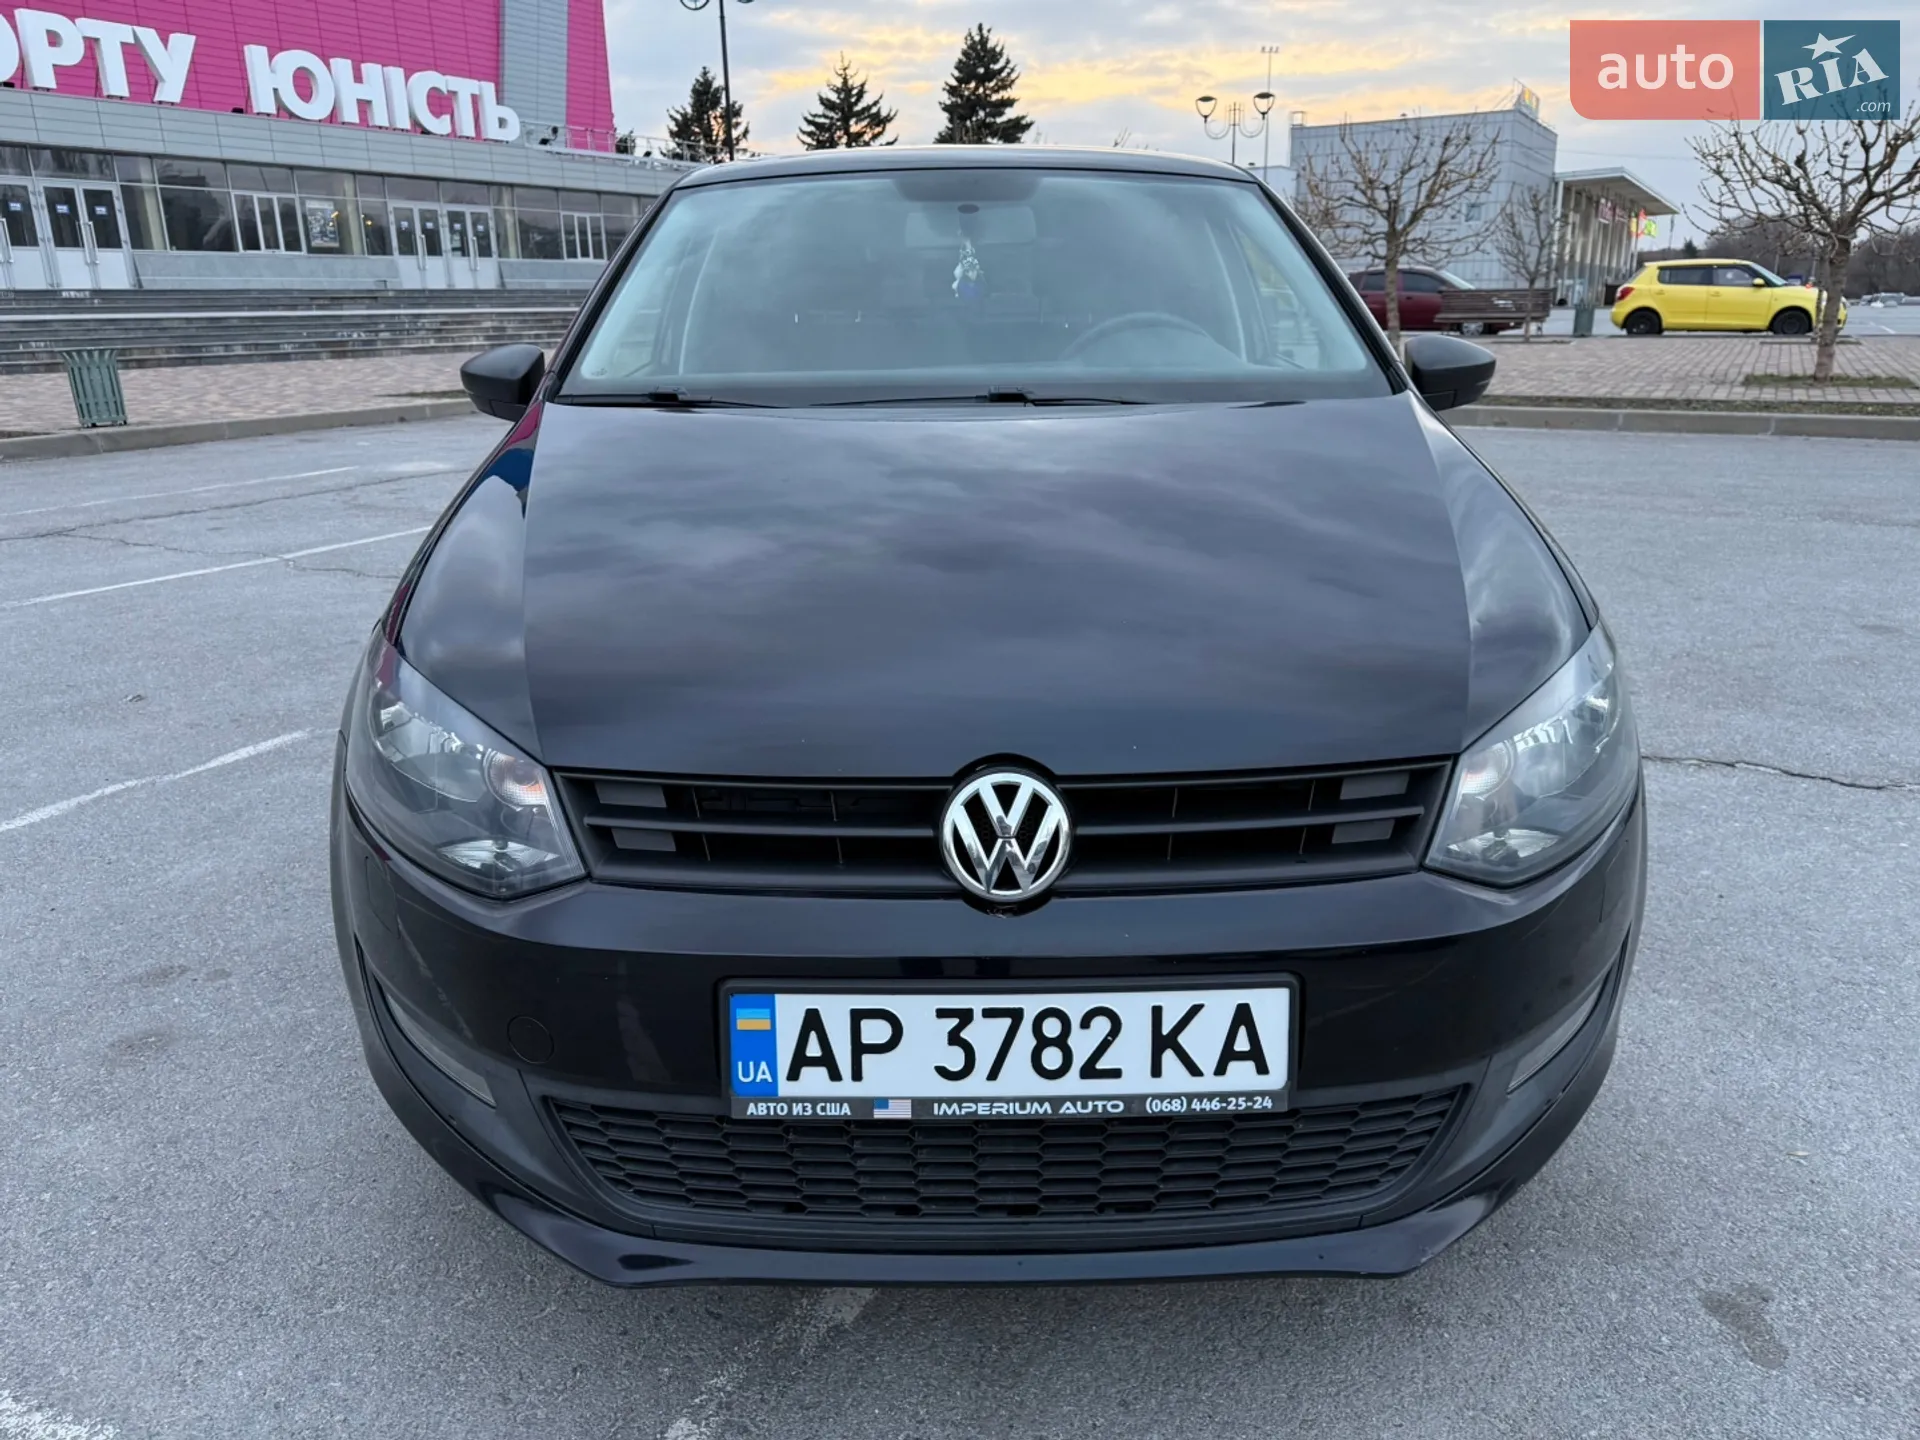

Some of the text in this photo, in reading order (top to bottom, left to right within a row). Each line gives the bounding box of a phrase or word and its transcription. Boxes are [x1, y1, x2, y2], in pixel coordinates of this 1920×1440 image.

[243, 44, 521, 143] ЮНІСТЬ
[786, 1002, 1270, 1083] AP 3782 KA
[738, 1060, 773, 1084] UA
[746, 1102, 851, 1116] АВТО ИЗ США
[933, 1100, 1125, 1116] IMPERIUM AUTO
[1145, 1096, 1273, 1113] (068) 446-25-24
